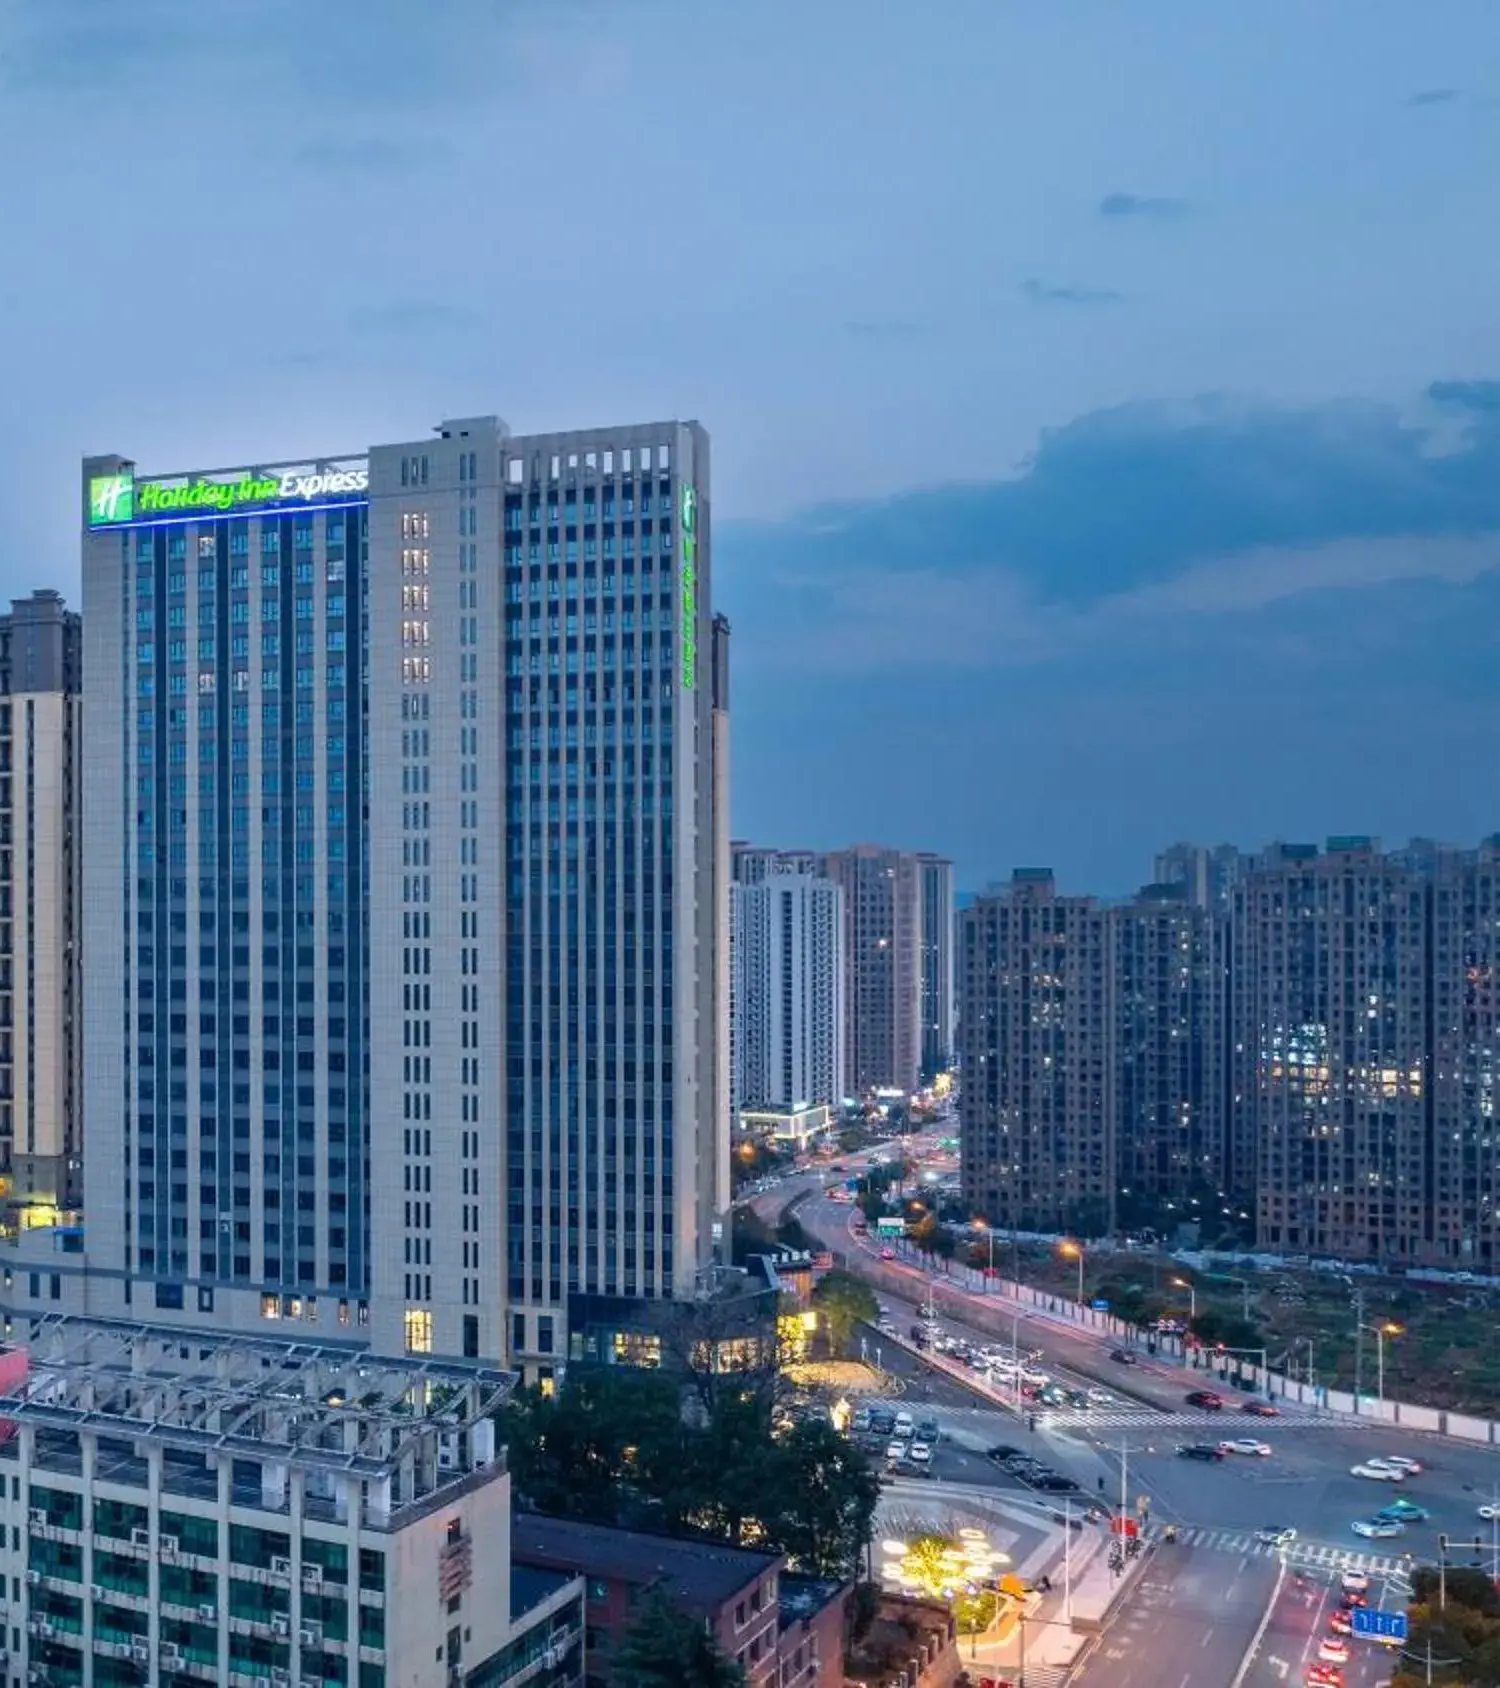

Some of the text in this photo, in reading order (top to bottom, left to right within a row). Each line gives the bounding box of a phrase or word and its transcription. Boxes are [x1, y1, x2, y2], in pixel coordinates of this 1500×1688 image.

[140, 470, 368, 509] Holiday Inn Express
